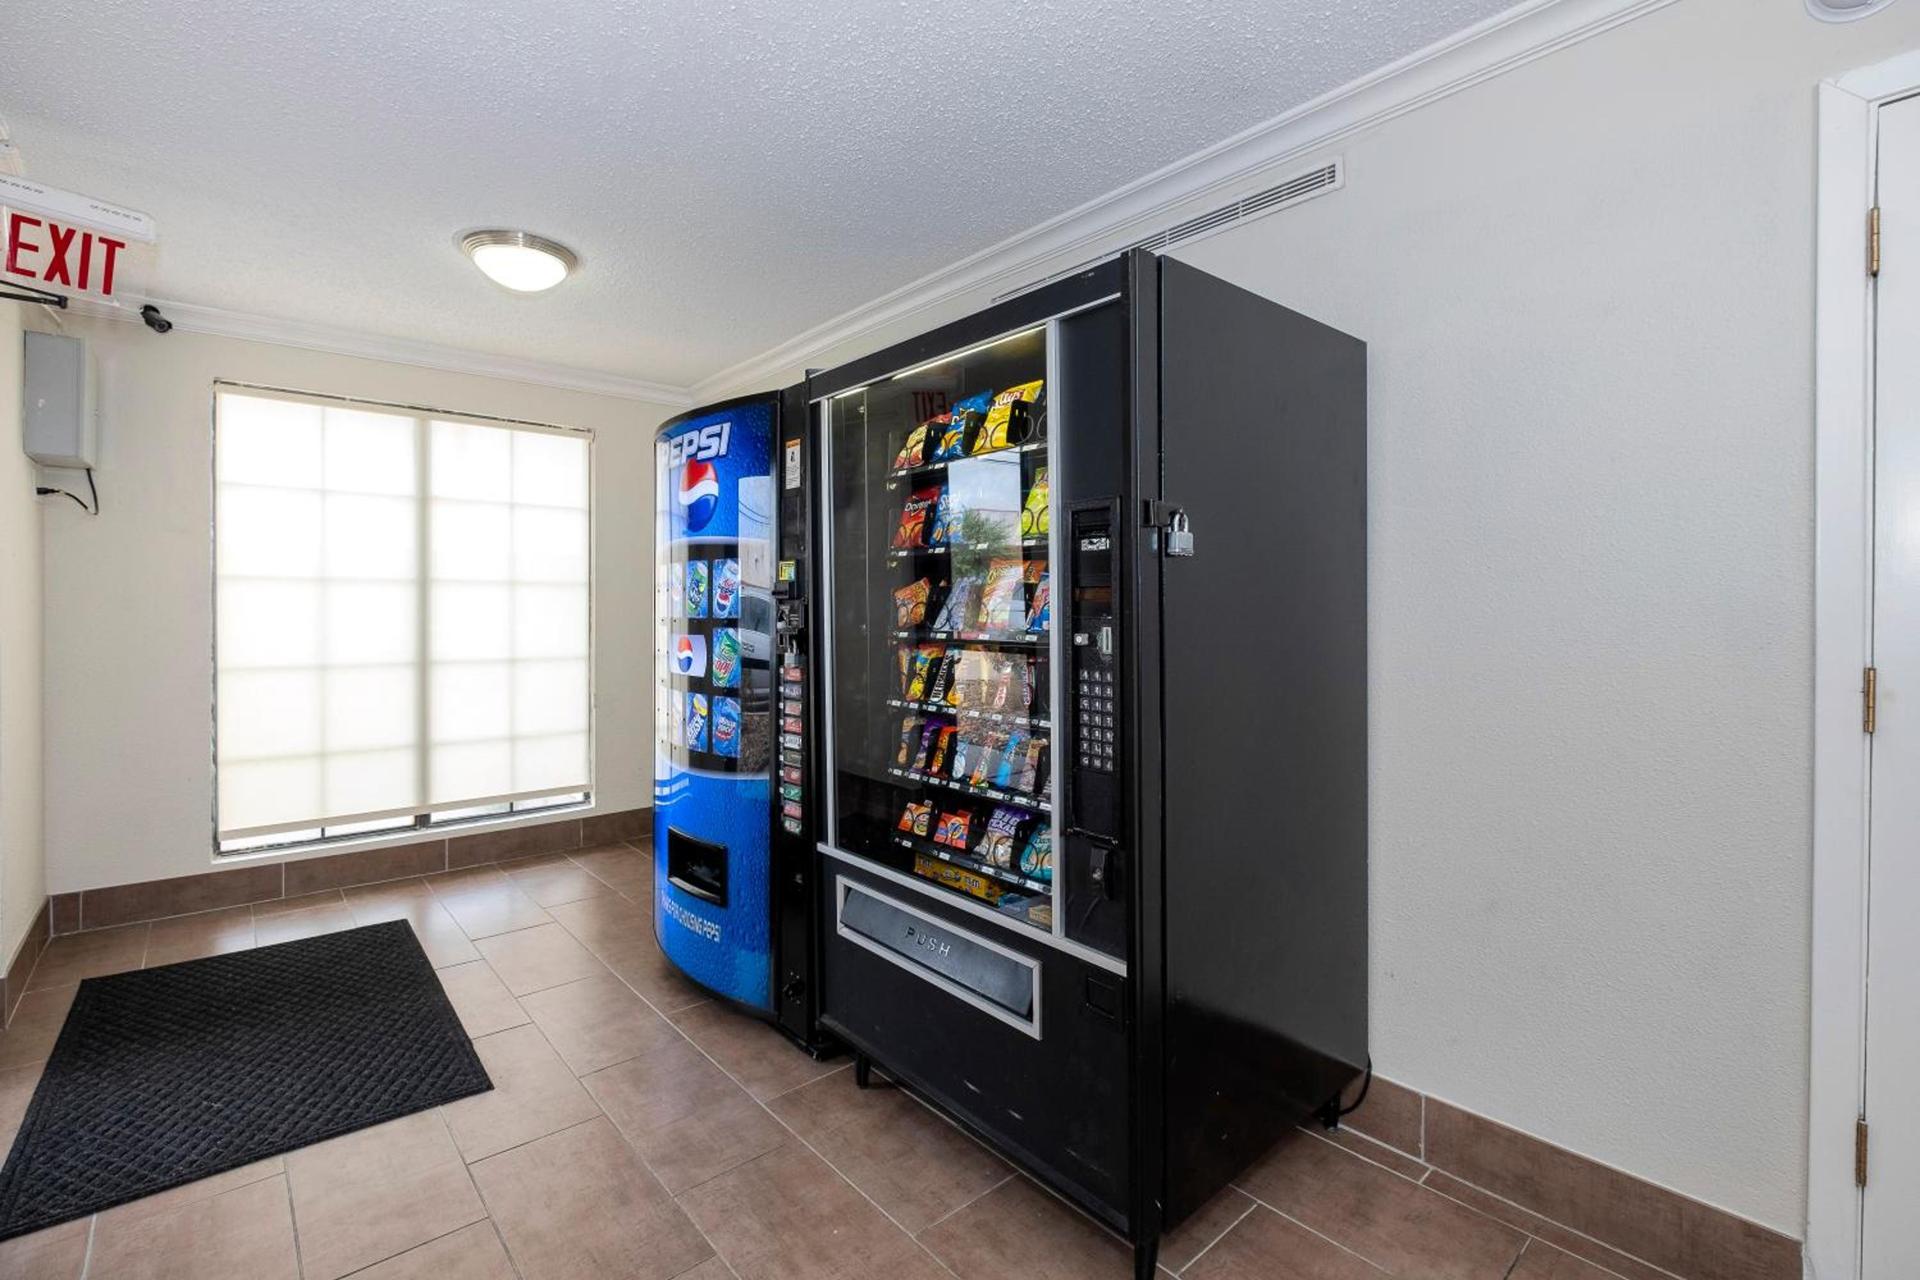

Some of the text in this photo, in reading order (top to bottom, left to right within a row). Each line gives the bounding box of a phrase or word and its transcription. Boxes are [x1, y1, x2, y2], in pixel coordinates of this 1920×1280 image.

[5, 213, 126, 296] EXIT
[658, 421, 732, 468] EPSI
[905, 926, 951, 957] PUSH
